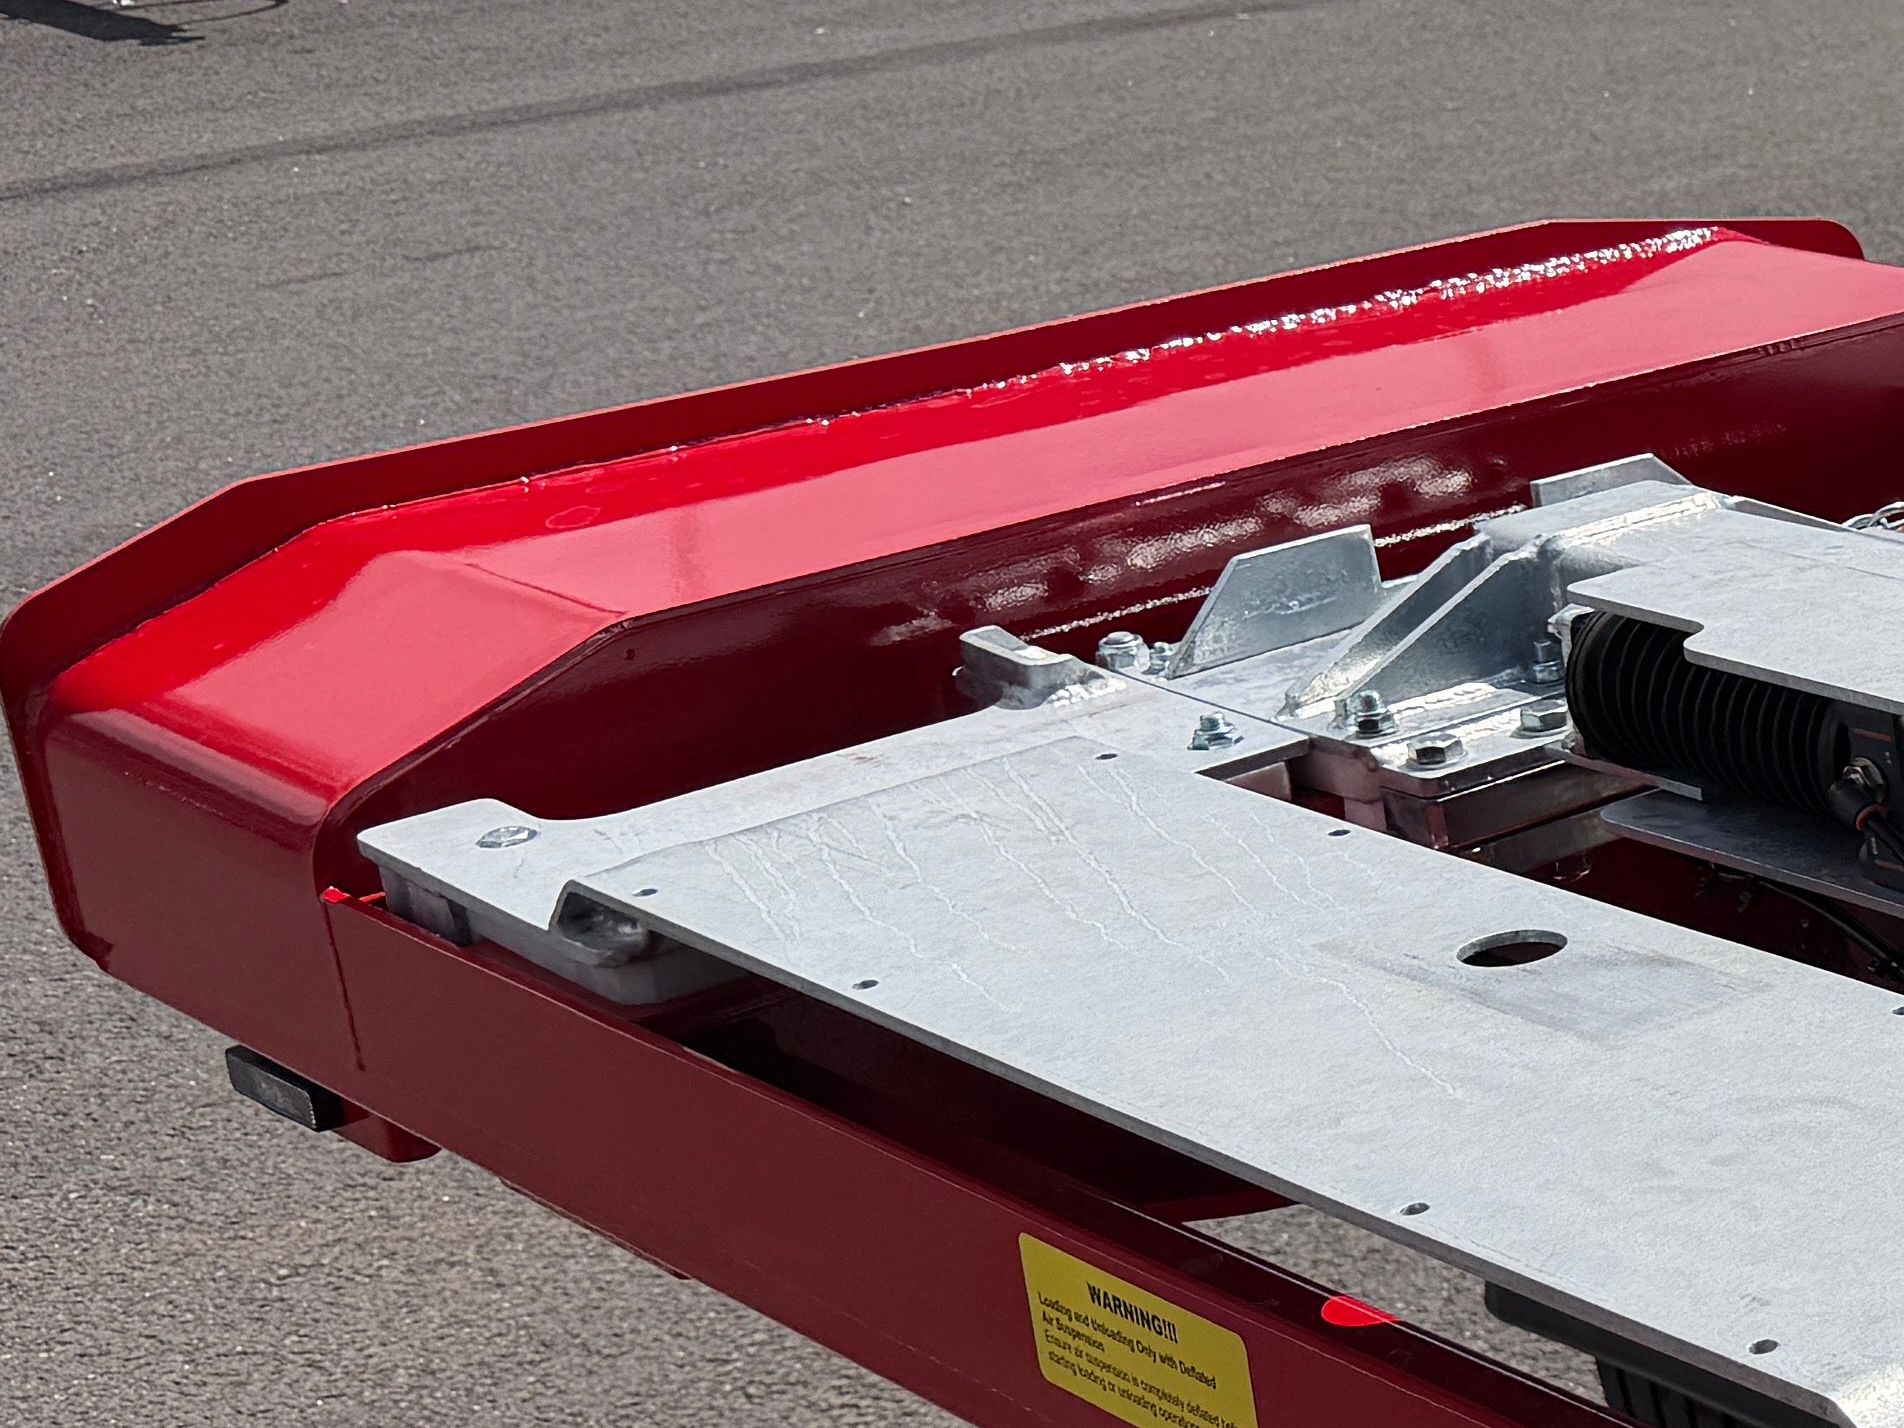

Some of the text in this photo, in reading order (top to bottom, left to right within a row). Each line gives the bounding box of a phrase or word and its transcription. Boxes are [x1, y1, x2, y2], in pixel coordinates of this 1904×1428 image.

[1073, 1310, 1089, 1328] and
[1135, 1339, 1156, 1363] Only
[1158, 1351, 1177, 1371] with
[1086, 1282, 1178, 1345] WARNING!!!
